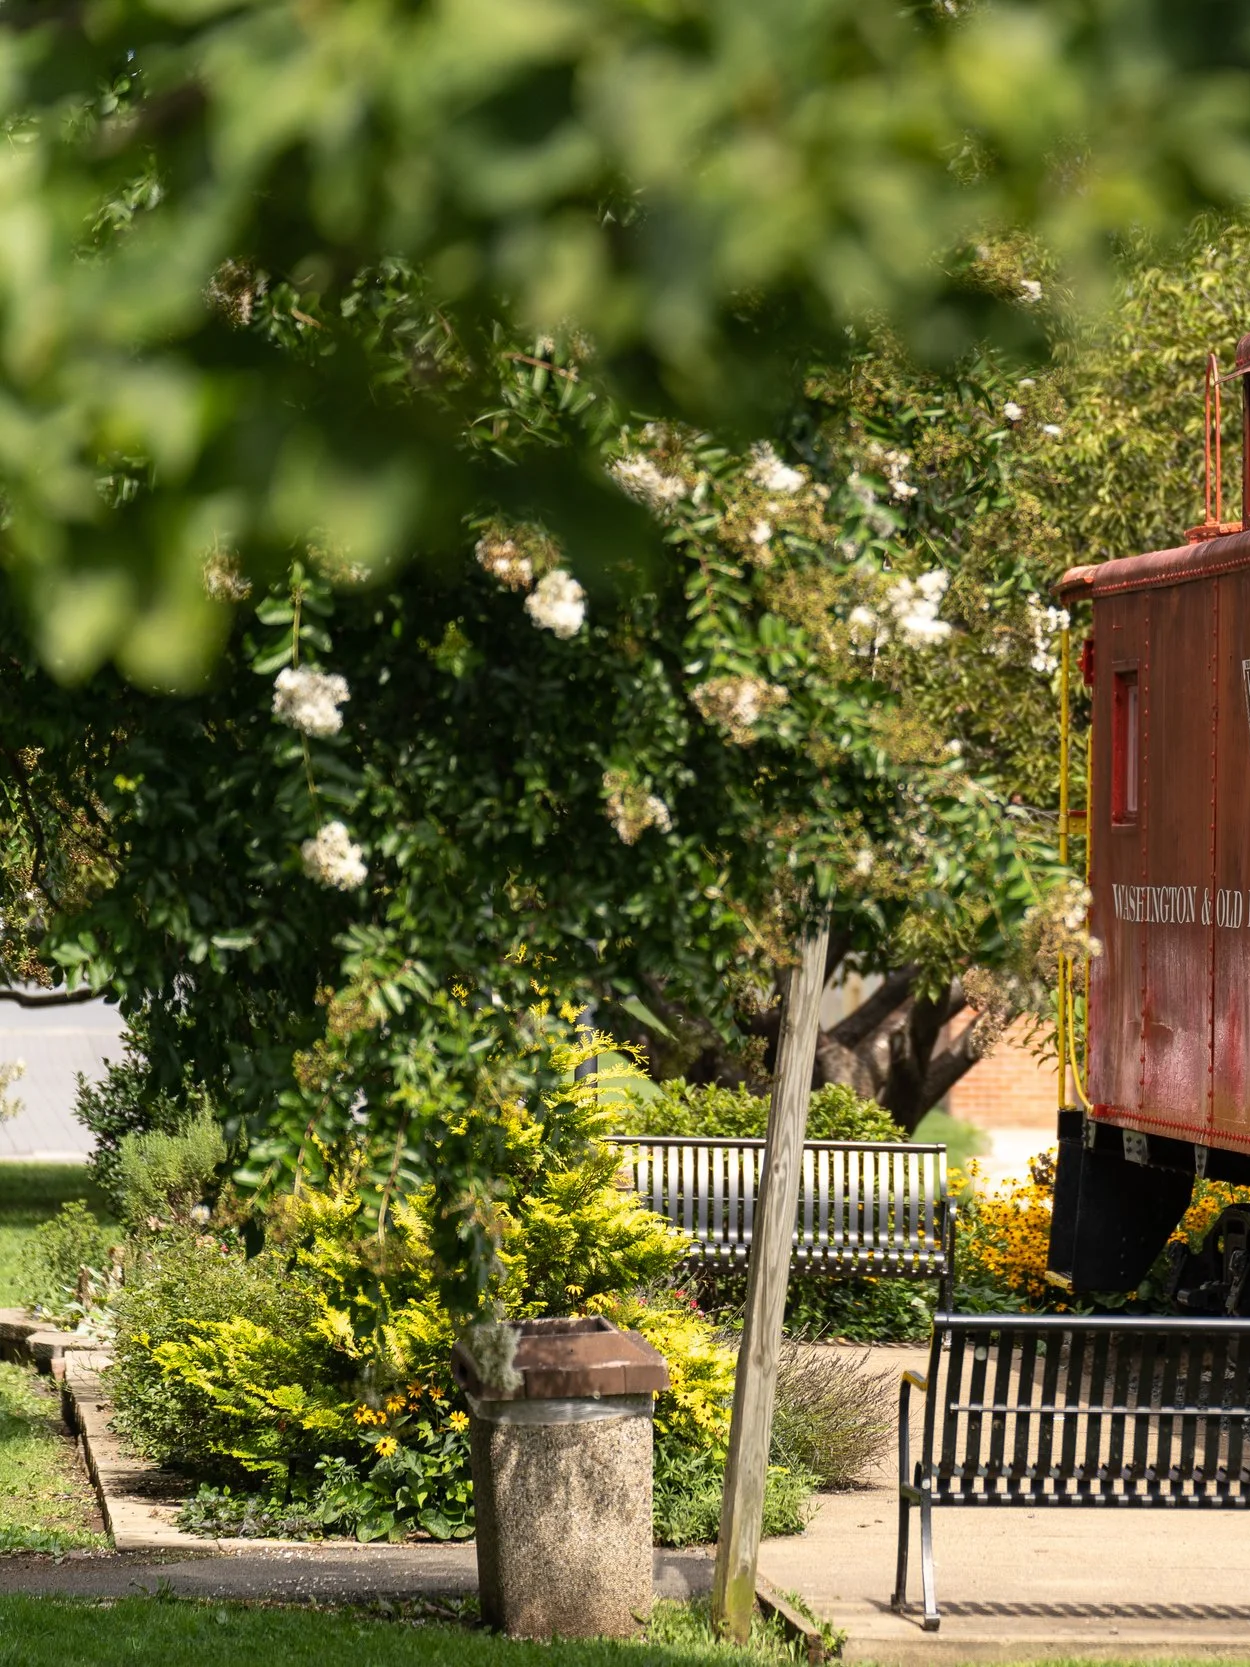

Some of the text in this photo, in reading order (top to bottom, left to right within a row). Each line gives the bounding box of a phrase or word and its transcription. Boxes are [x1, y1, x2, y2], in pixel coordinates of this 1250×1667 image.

[1112, 883, 1198, 924] WASHINGTON
[1201, 887, 1213, 926] &
[1216, 888, 1243, 929] OLD
